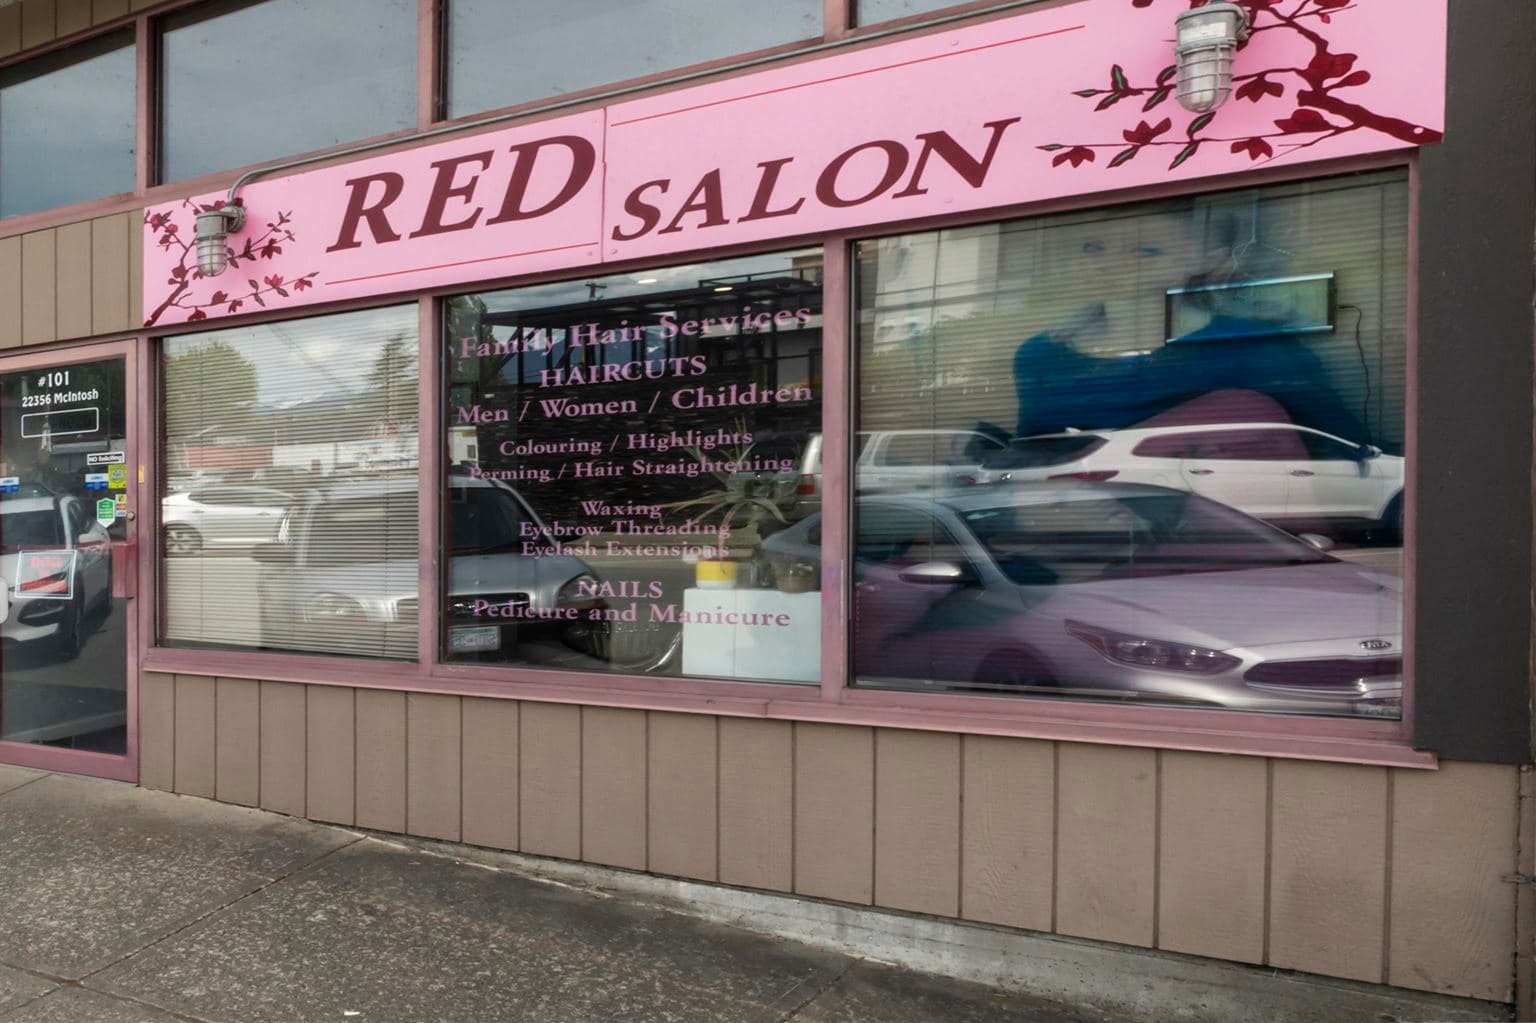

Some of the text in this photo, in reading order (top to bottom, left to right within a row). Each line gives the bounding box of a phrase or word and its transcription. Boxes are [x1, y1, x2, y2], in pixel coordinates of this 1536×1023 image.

[326, 117, 1023, 253] RED SALON
[568, 319, 646, 349] Hair
[659, 304, 812, 339] Services
[38, 371, 70, 388] #101
[539, 355, 708, 388] HAIRCUTS
[22, 388, 99, 408] 22356 McIntosh
[457, 382, 812, 425] Men / Women / Children
[499, 428, 753, 458] Colouring / Highlights
[469, 455, 794, 482] Perming / Hair Straightening
[580, 499, 662, 520] Waxing
[519, 518, 732, 539] Eyebrow Threading
[520, 539, 730, 560] Eyelash Extensions
[575, 580, 664, 600] NAILS
[473, 597, 792, 629] Pedicure and Manicure
